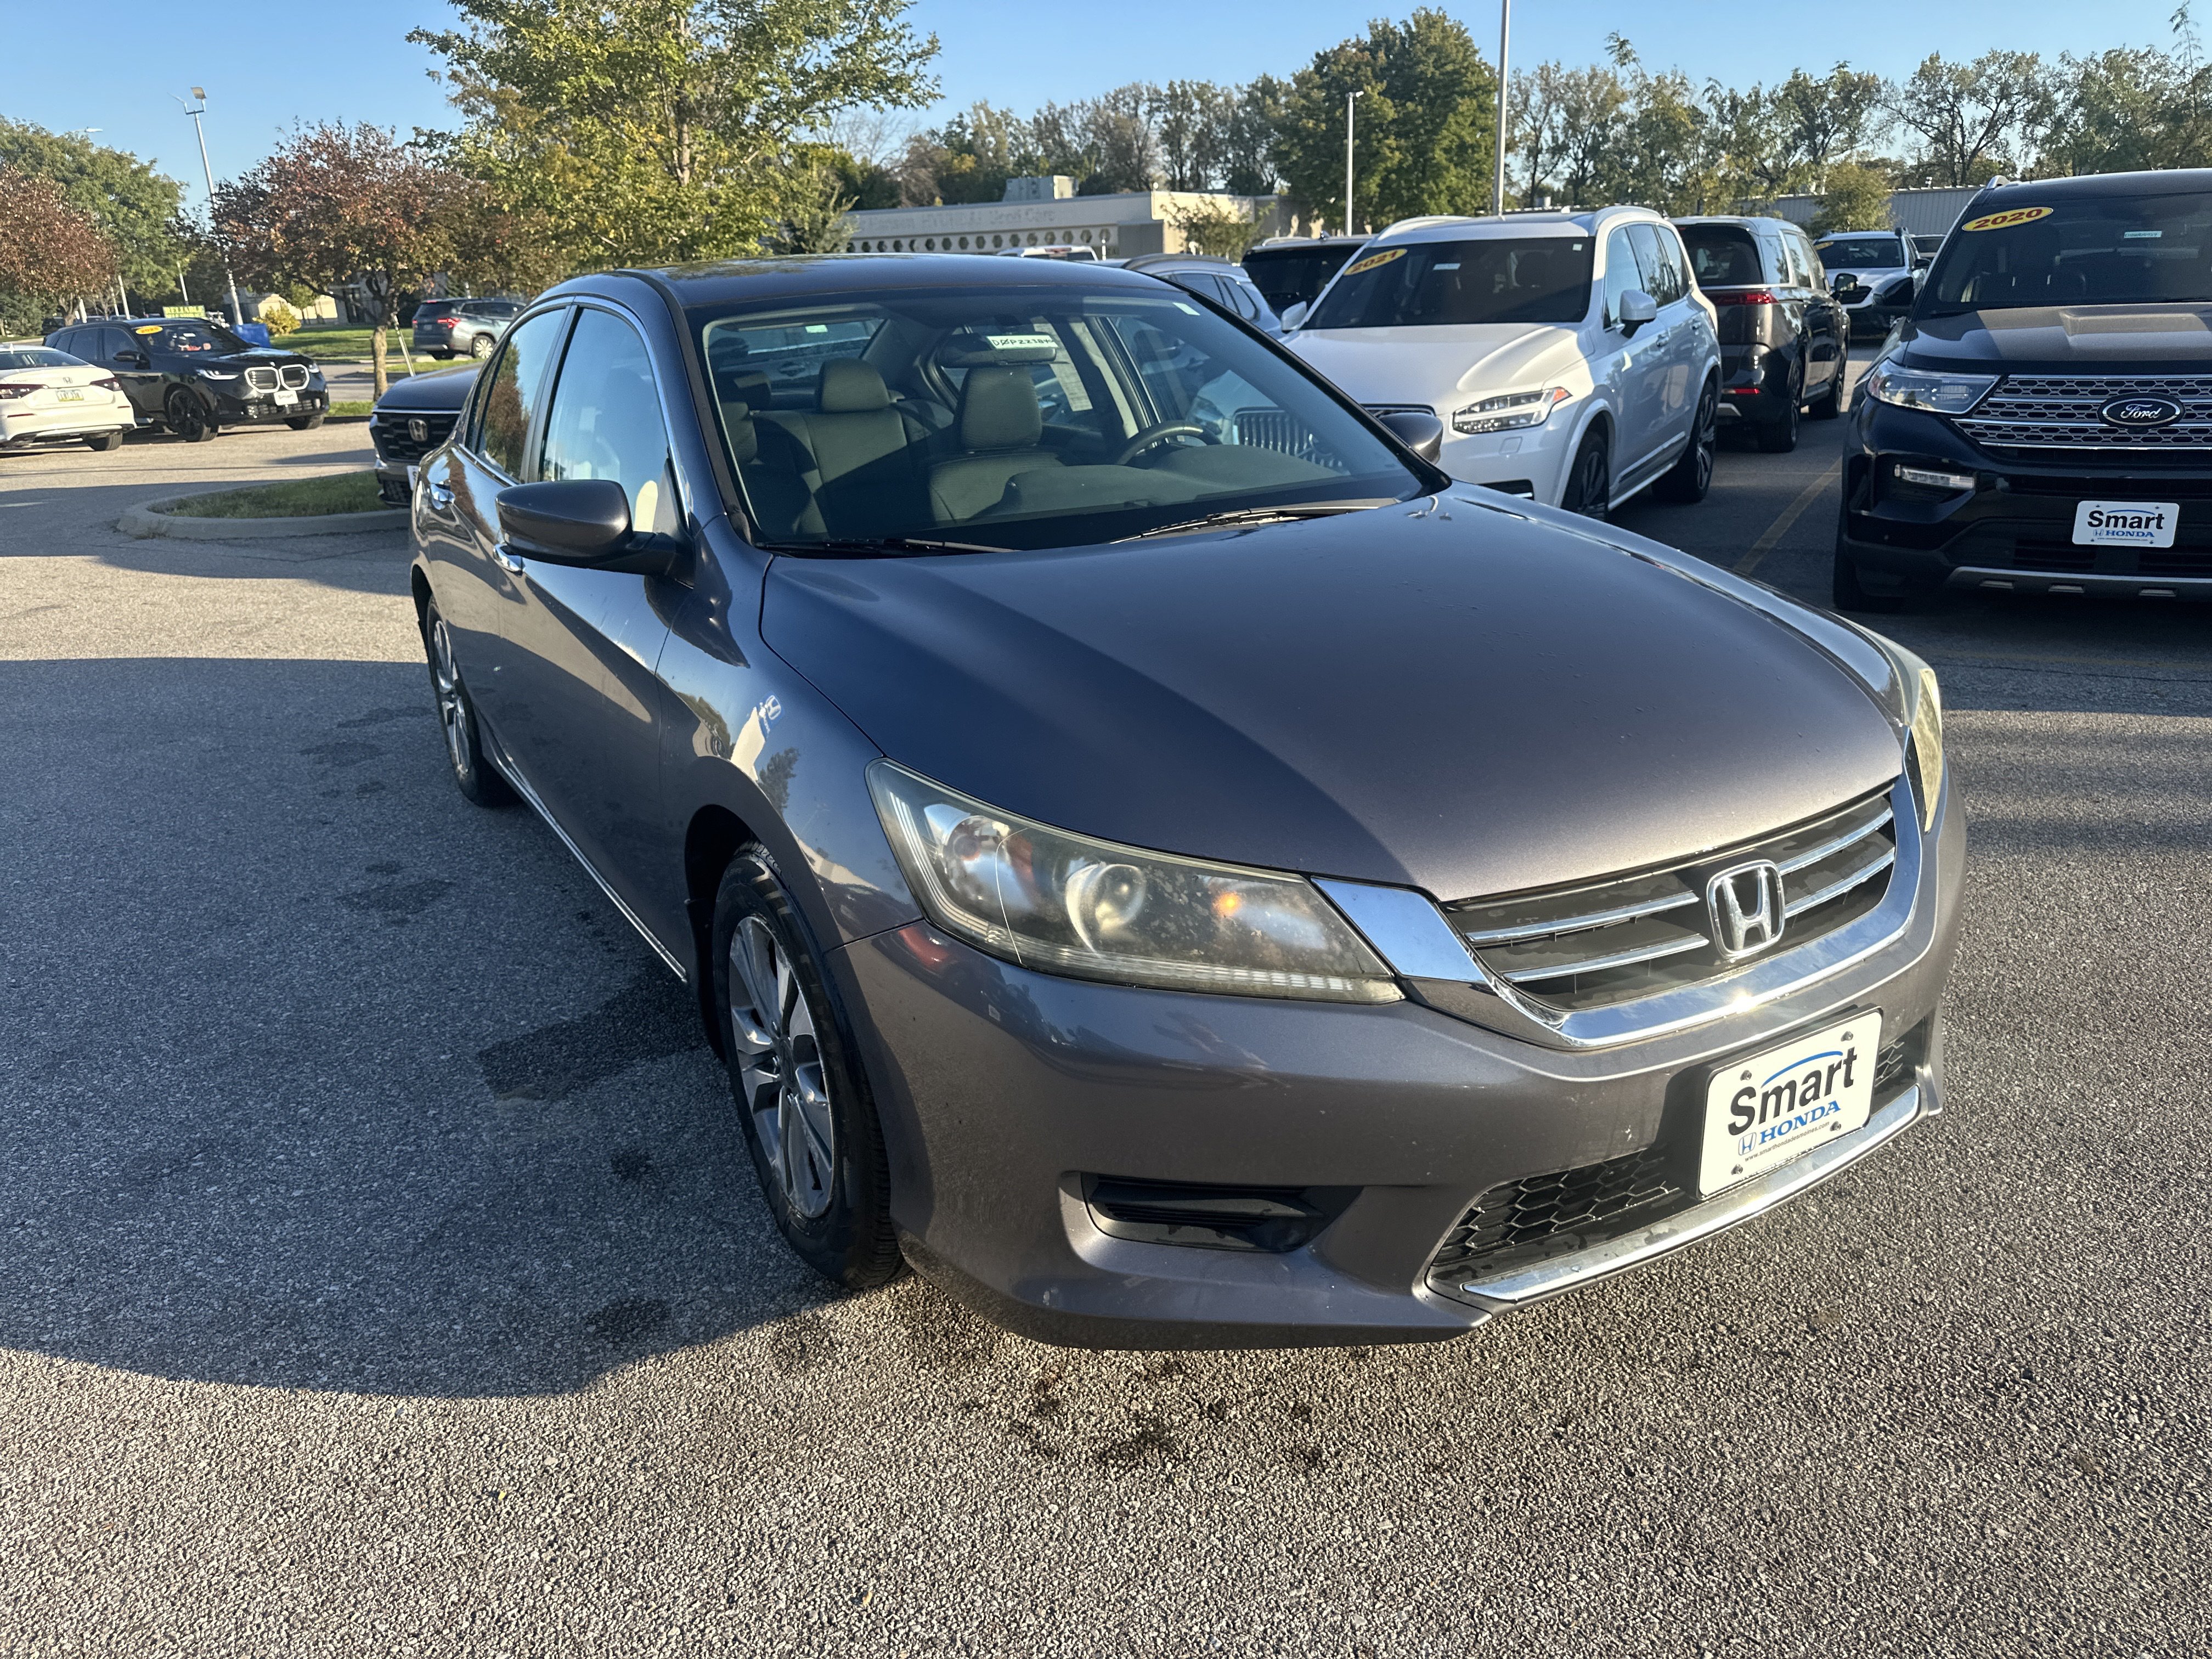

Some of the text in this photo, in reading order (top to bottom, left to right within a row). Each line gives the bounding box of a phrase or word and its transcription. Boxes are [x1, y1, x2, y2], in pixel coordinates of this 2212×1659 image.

[1973, 208, 2042, 230] 2020
[1351, 251, 1398, 272] 2021
[2120, 403, 2162, 419] Ford
[2087, 510, 2165, 529] Smart
[1728, 1046, 1858, 1136] Smart
[1758, 1100, 1841, 1145] HONDA
[1745, 1121, 1830, 1162] www.smarthondadesmoines.com
